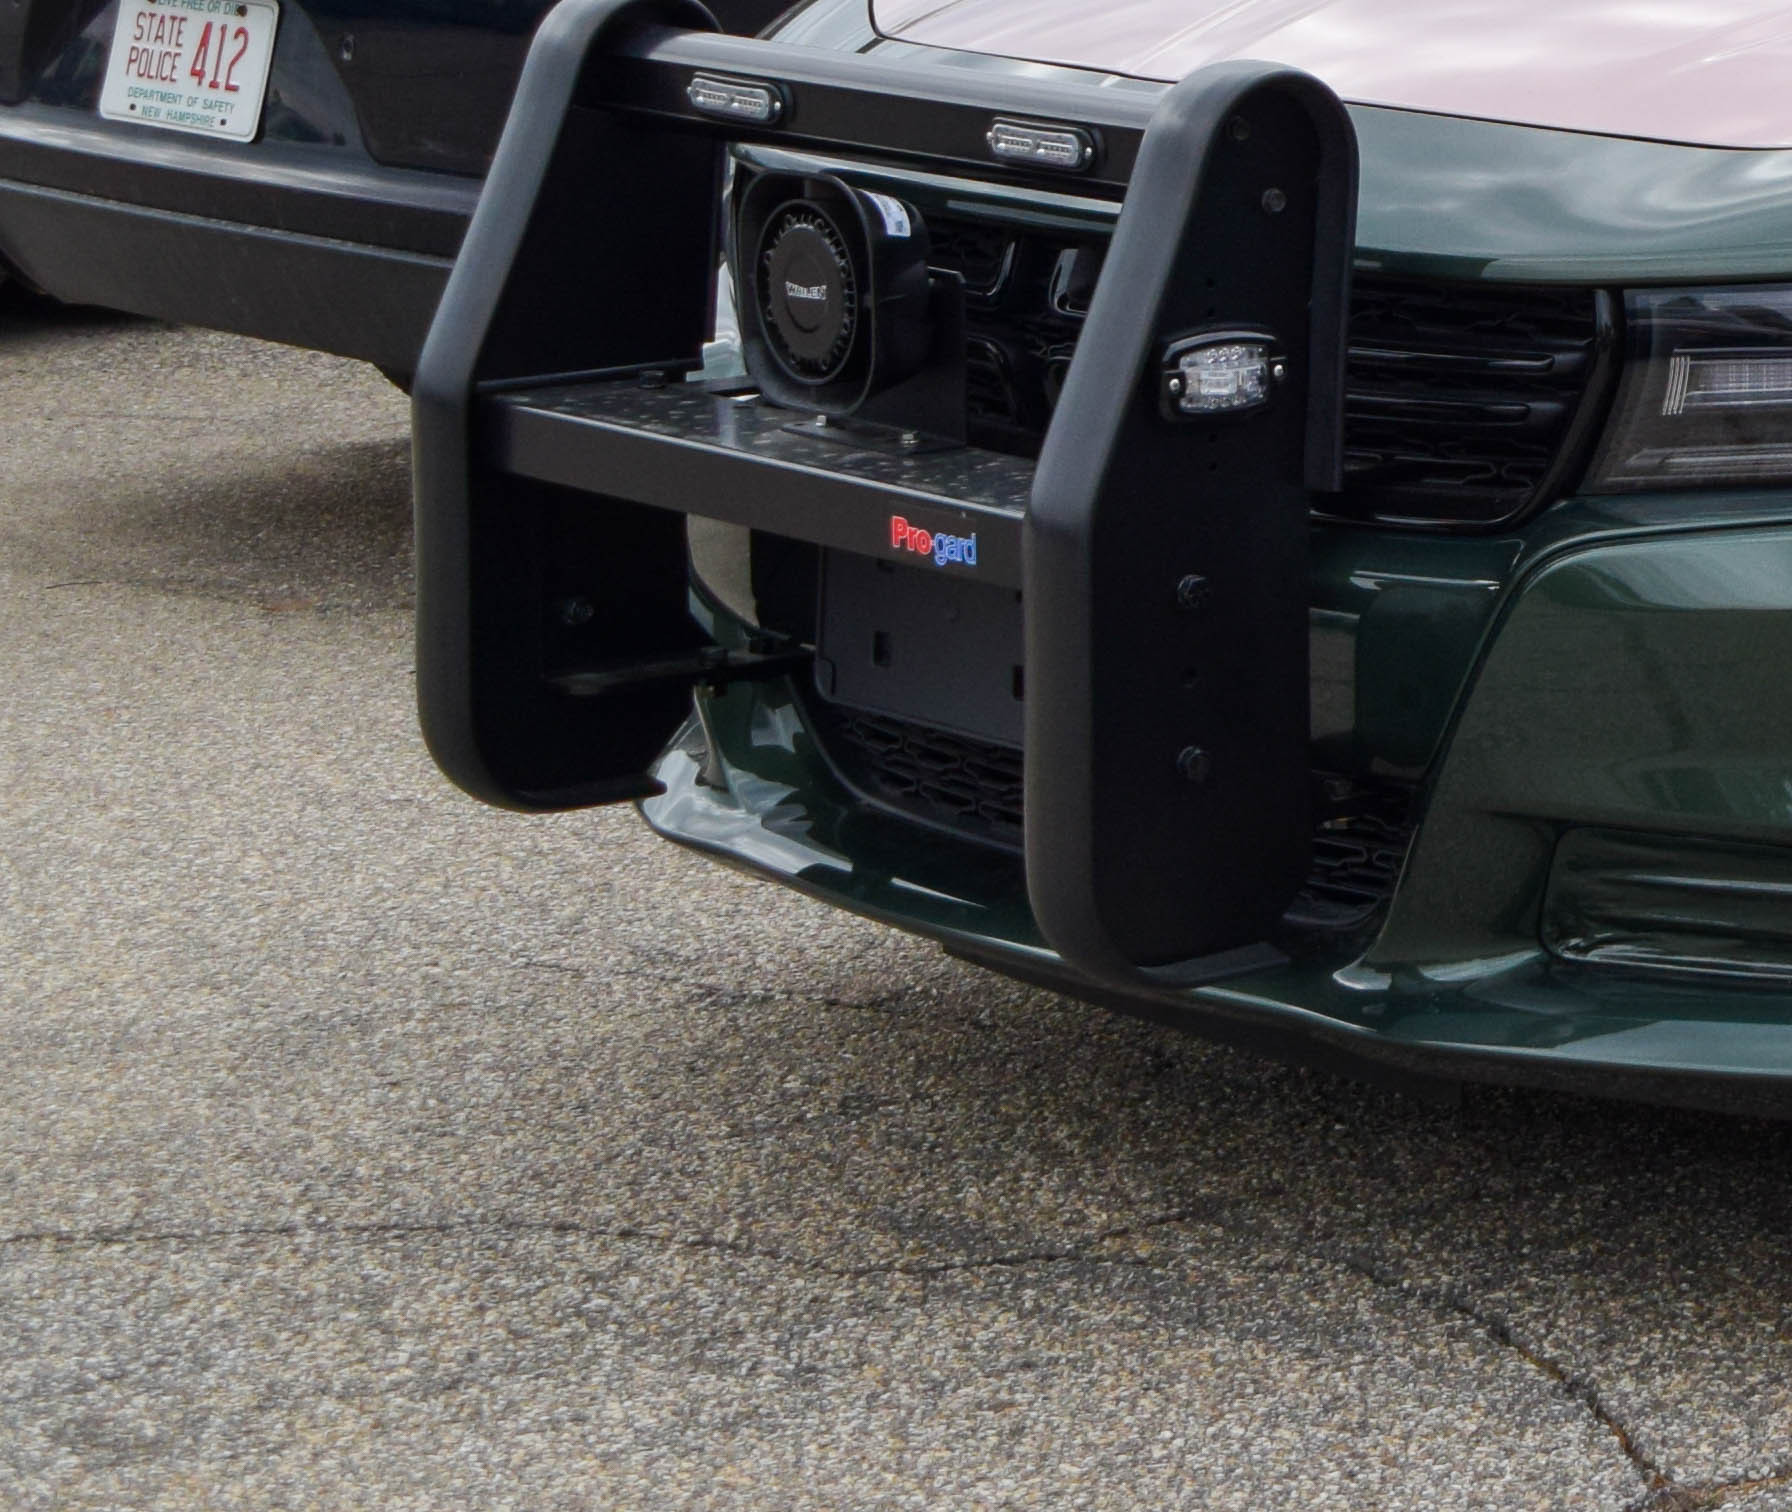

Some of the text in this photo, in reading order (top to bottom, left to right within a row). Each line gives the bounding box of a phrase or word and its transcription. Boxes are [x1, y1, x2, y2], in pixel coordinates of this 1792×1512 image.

[207, 1, 220, 14] OR
[134, 11, 187, 47] STATE
[126, 45, 181, 83] POLICE
[190, 21, 249, 92] 412
[128, 86, 236, 114] DEPARTMENT OF SAFETY
[141, 105, 216, 127] NEW HAMPSHIRE
[891, 515, 977, 566] Pro-gard
